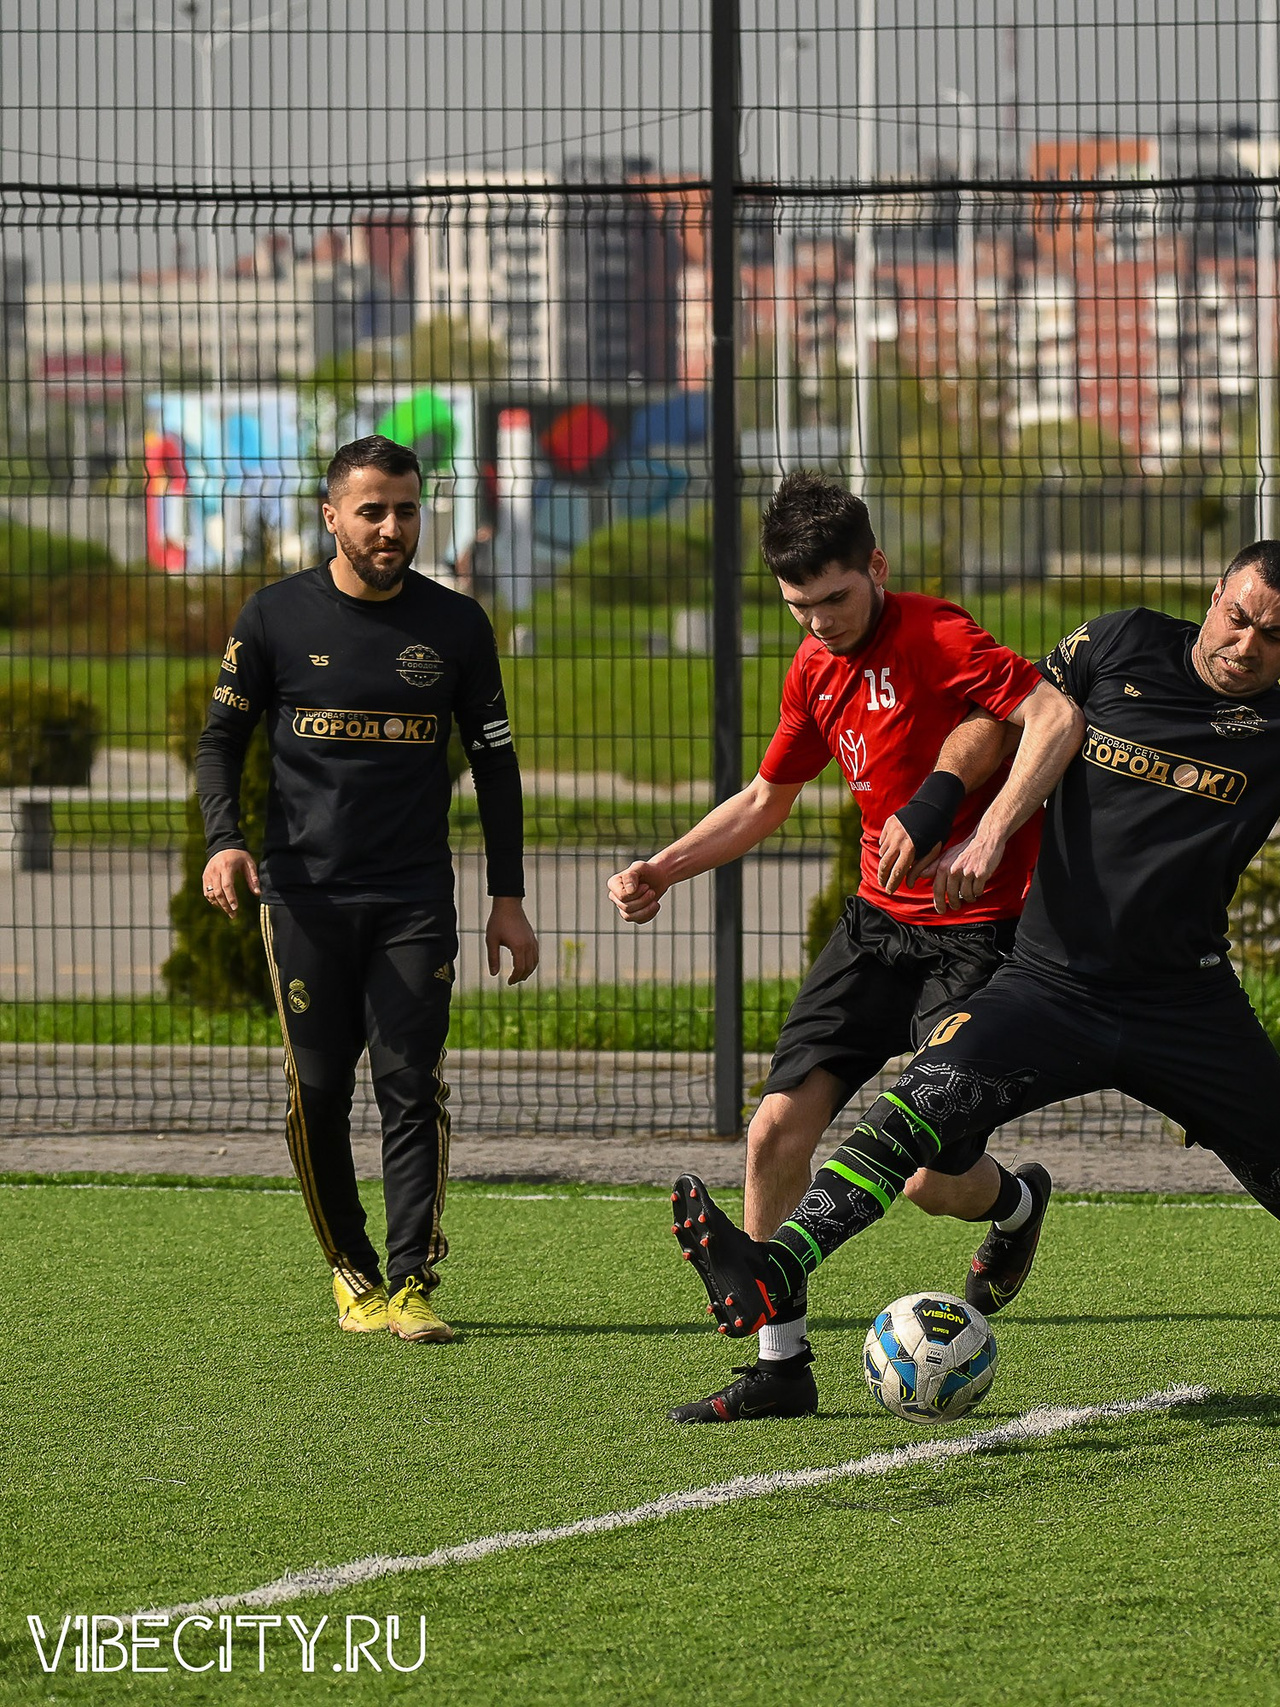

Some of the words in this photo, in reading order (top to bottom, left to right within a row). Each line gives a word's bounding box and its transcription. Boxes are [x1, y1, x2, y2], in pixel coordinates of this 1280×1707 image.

[864, 667, 896, 711] 15
[305, 711, 345, 719] ТОРГОВАЯ
[347, 713, 369, 721] СЕТЬ
[1091, 730, 1133, 753] ТОРГОВАЯ
[1134, 746, 1160, 761] СЕТЬ
[922, 1309, 965, 1325] VISION
